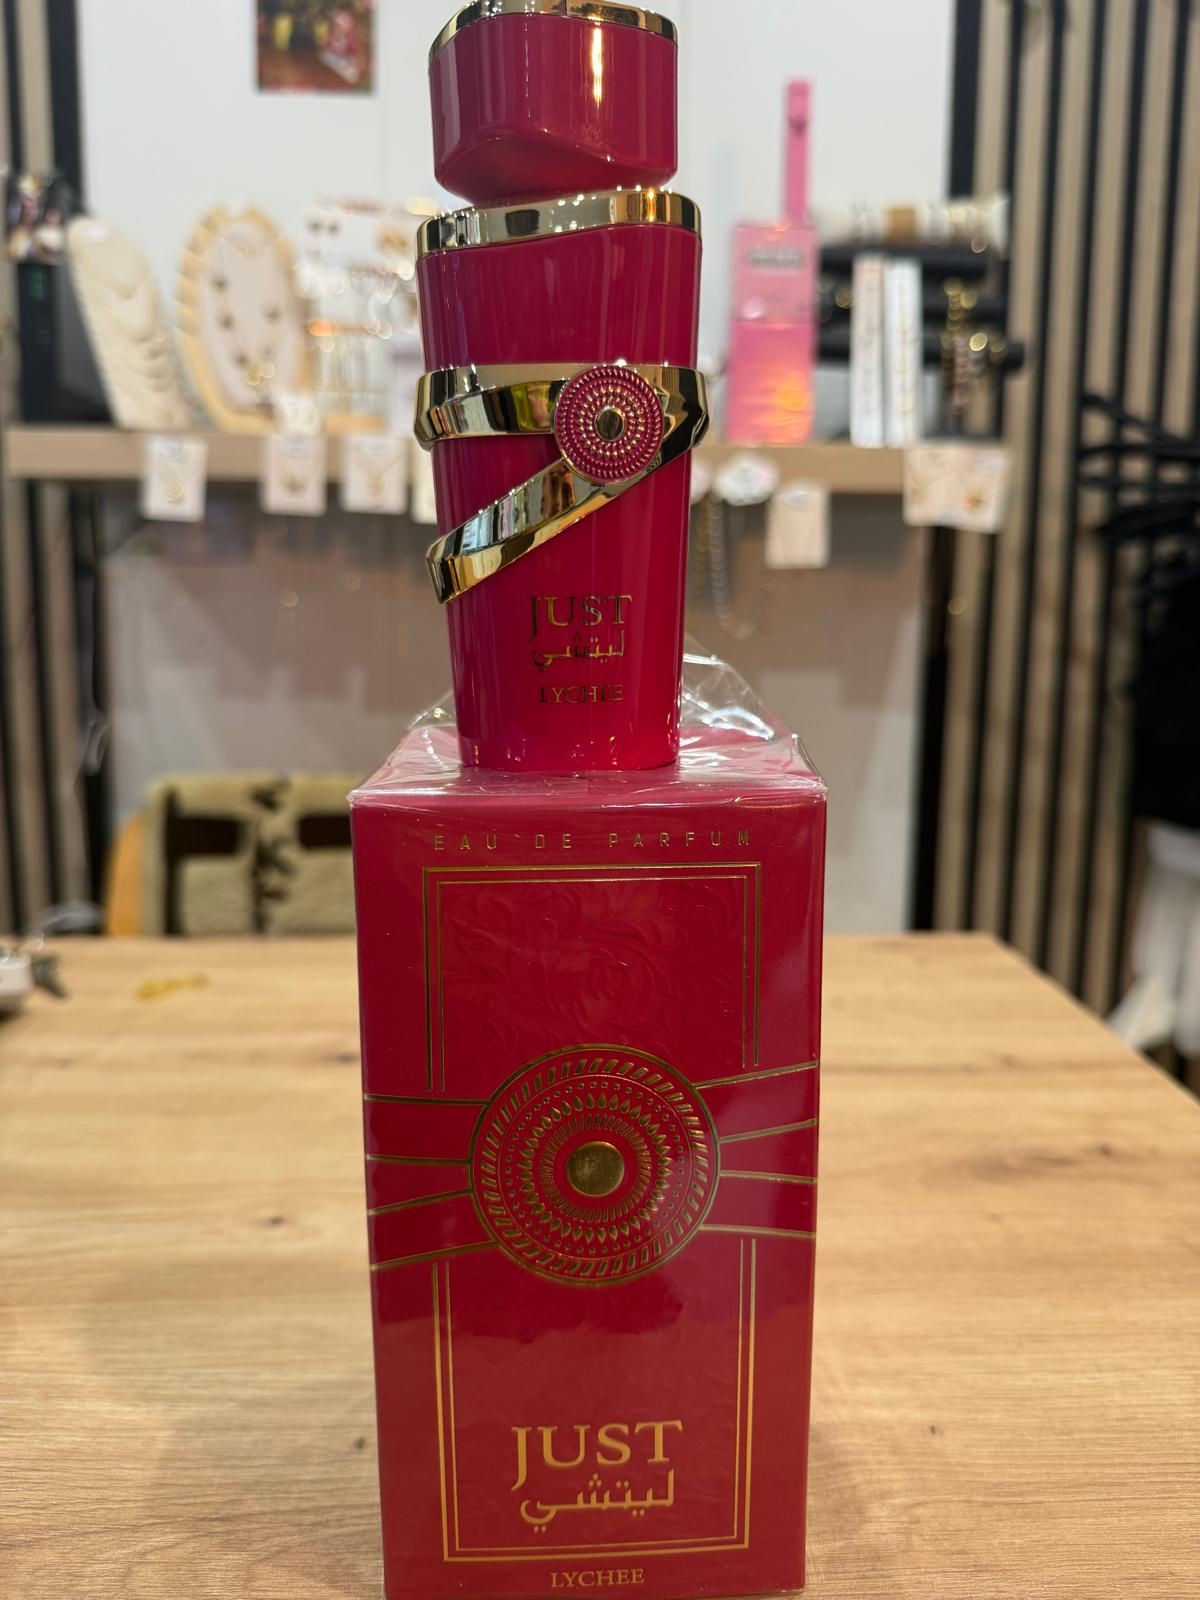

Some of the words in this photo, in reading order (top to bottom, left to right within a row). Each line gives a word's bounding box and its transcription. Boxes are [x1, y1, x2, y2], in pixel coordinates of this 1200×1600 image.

[528, 594, 633, 641] JUST
[531, 631, 625, 671] ليتشي
[539, 684, 624, 705] LYCHEE
[434, 834, 497, 850] EAU
[535, 833, 572, 849] DE
[608, 831, 750, 847] PARFUM
[511, 1420, 684, 1492] JUST
[520, 1468, 675, 1534] ليتشي
[551, 1568, 645, 1588] LYCHEE
